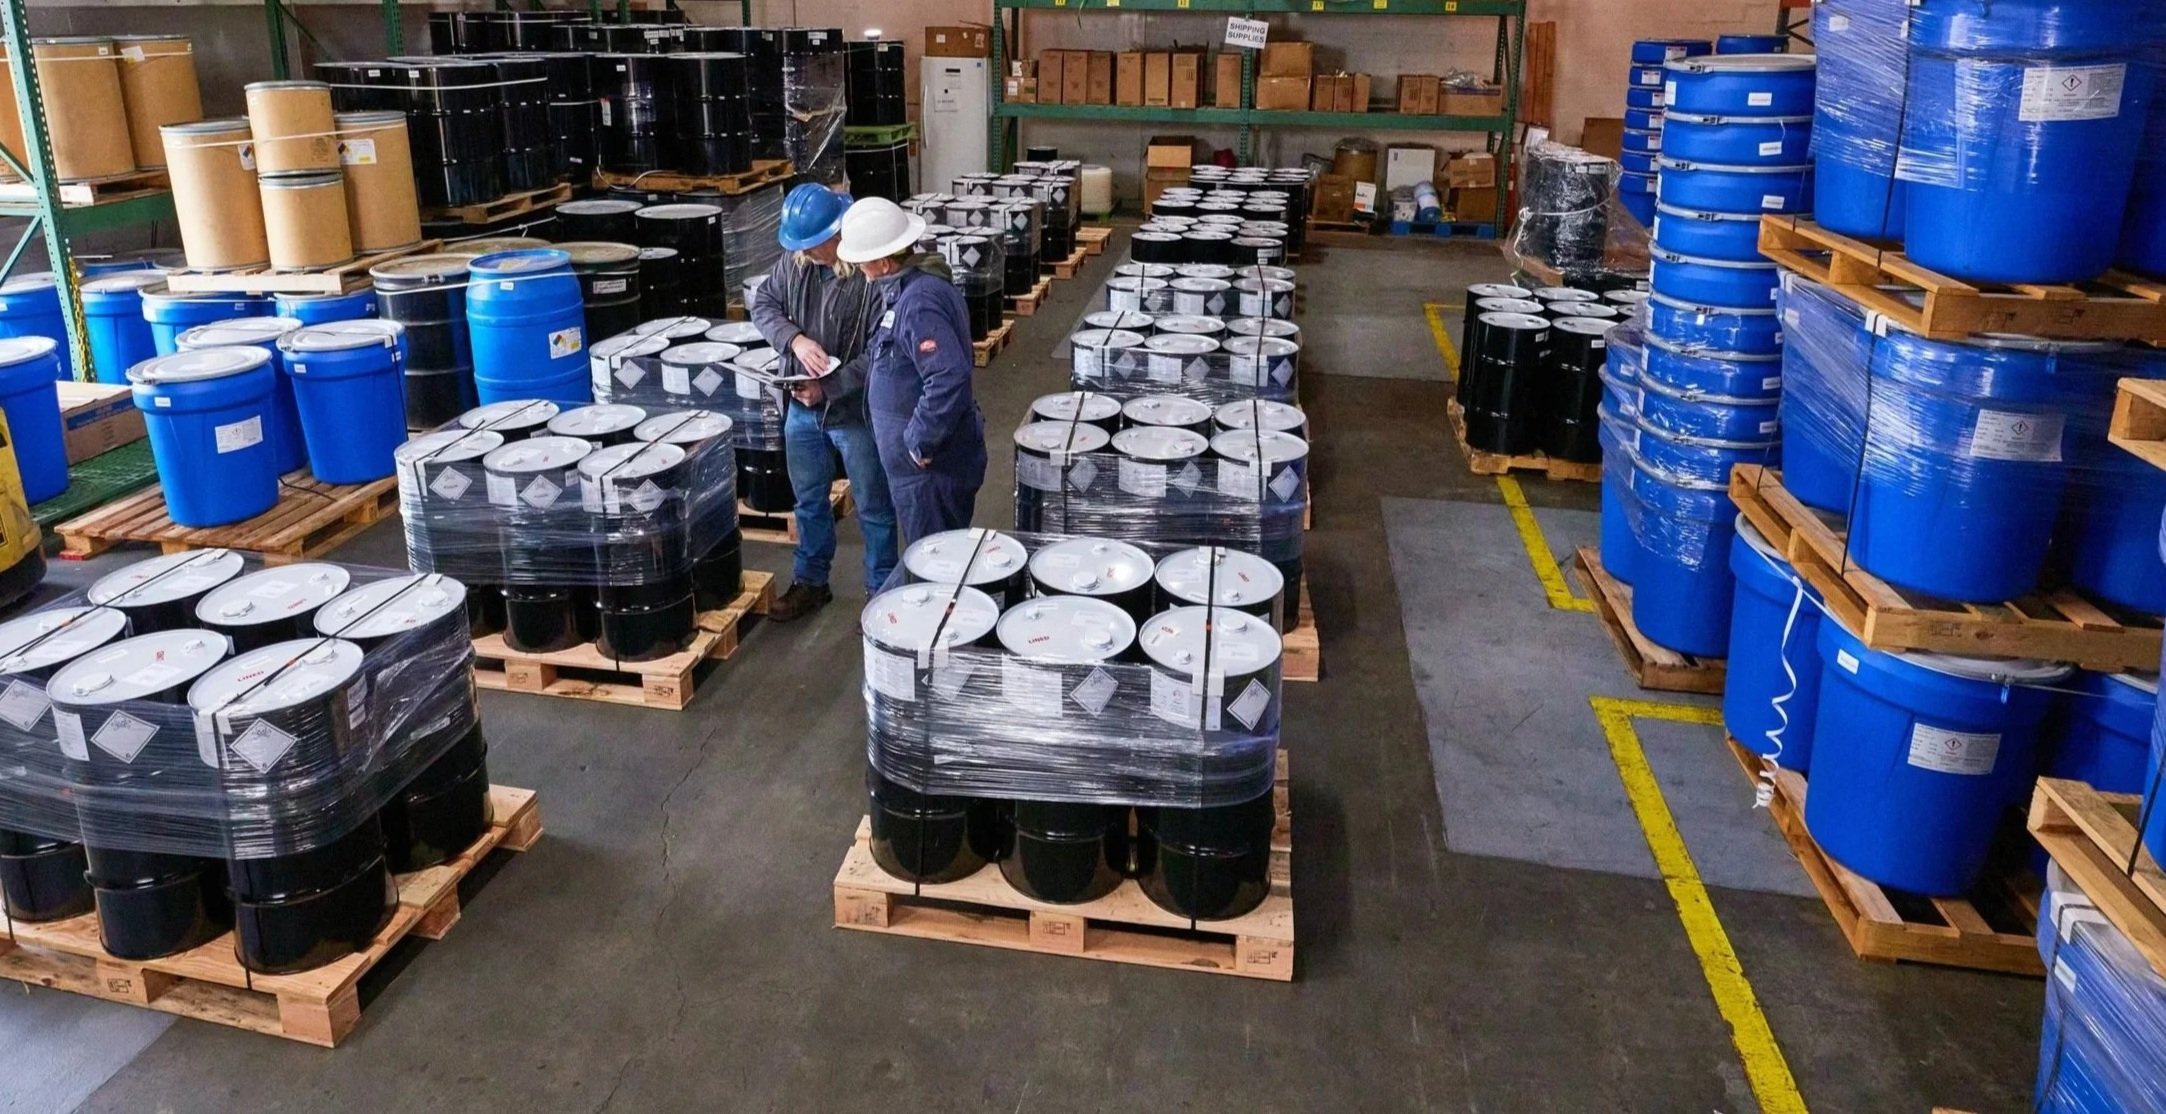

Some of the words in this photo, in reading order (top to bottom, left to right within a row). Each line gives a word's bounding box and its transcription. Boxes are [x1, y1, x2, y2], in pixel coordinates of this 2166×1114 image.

[1230, 23, 1265, 34] SHIPPING
[1228, 31, 1264, 43] SUPPLIES
[1028, 635, 1050, 644] LINED
[237, 670, 264, 682] LINED
